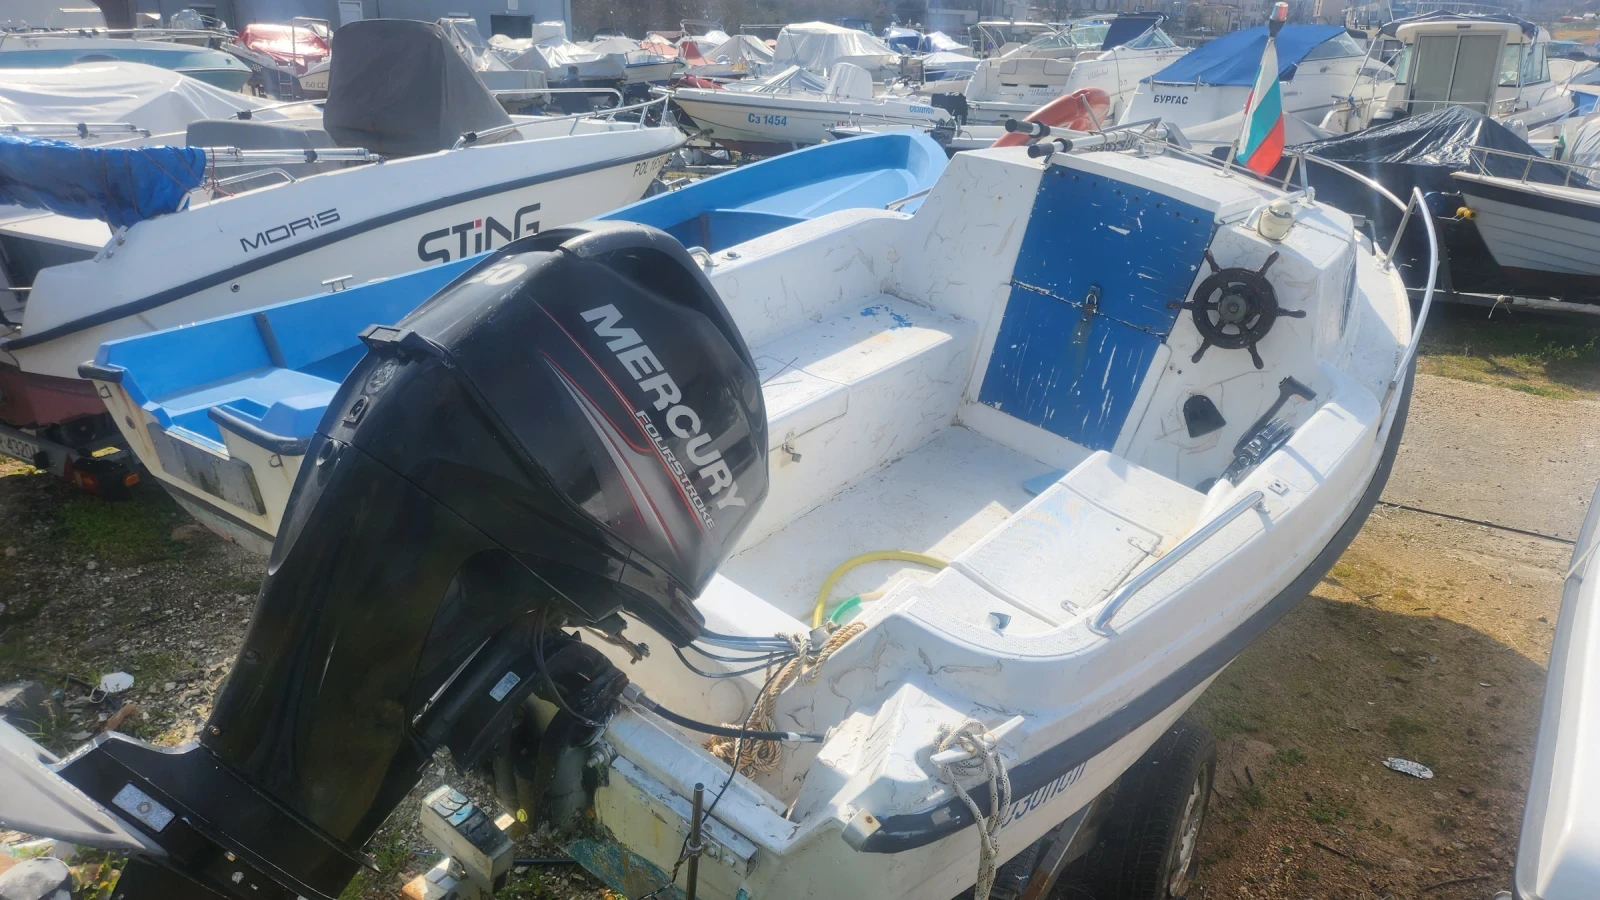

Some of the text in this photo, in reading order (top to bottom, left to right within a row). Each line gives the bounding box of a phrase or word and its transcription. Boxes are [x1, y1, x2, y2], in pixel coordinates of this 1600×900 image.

[1153, 94, 1189, 105] БУРГАС
[763, 114, 788, 126] 1454
[632, 161, 650, 178] POL
[579, 303, 747, 510] MERCURY
[634, 410, 716, 530] FOURSTROKE
